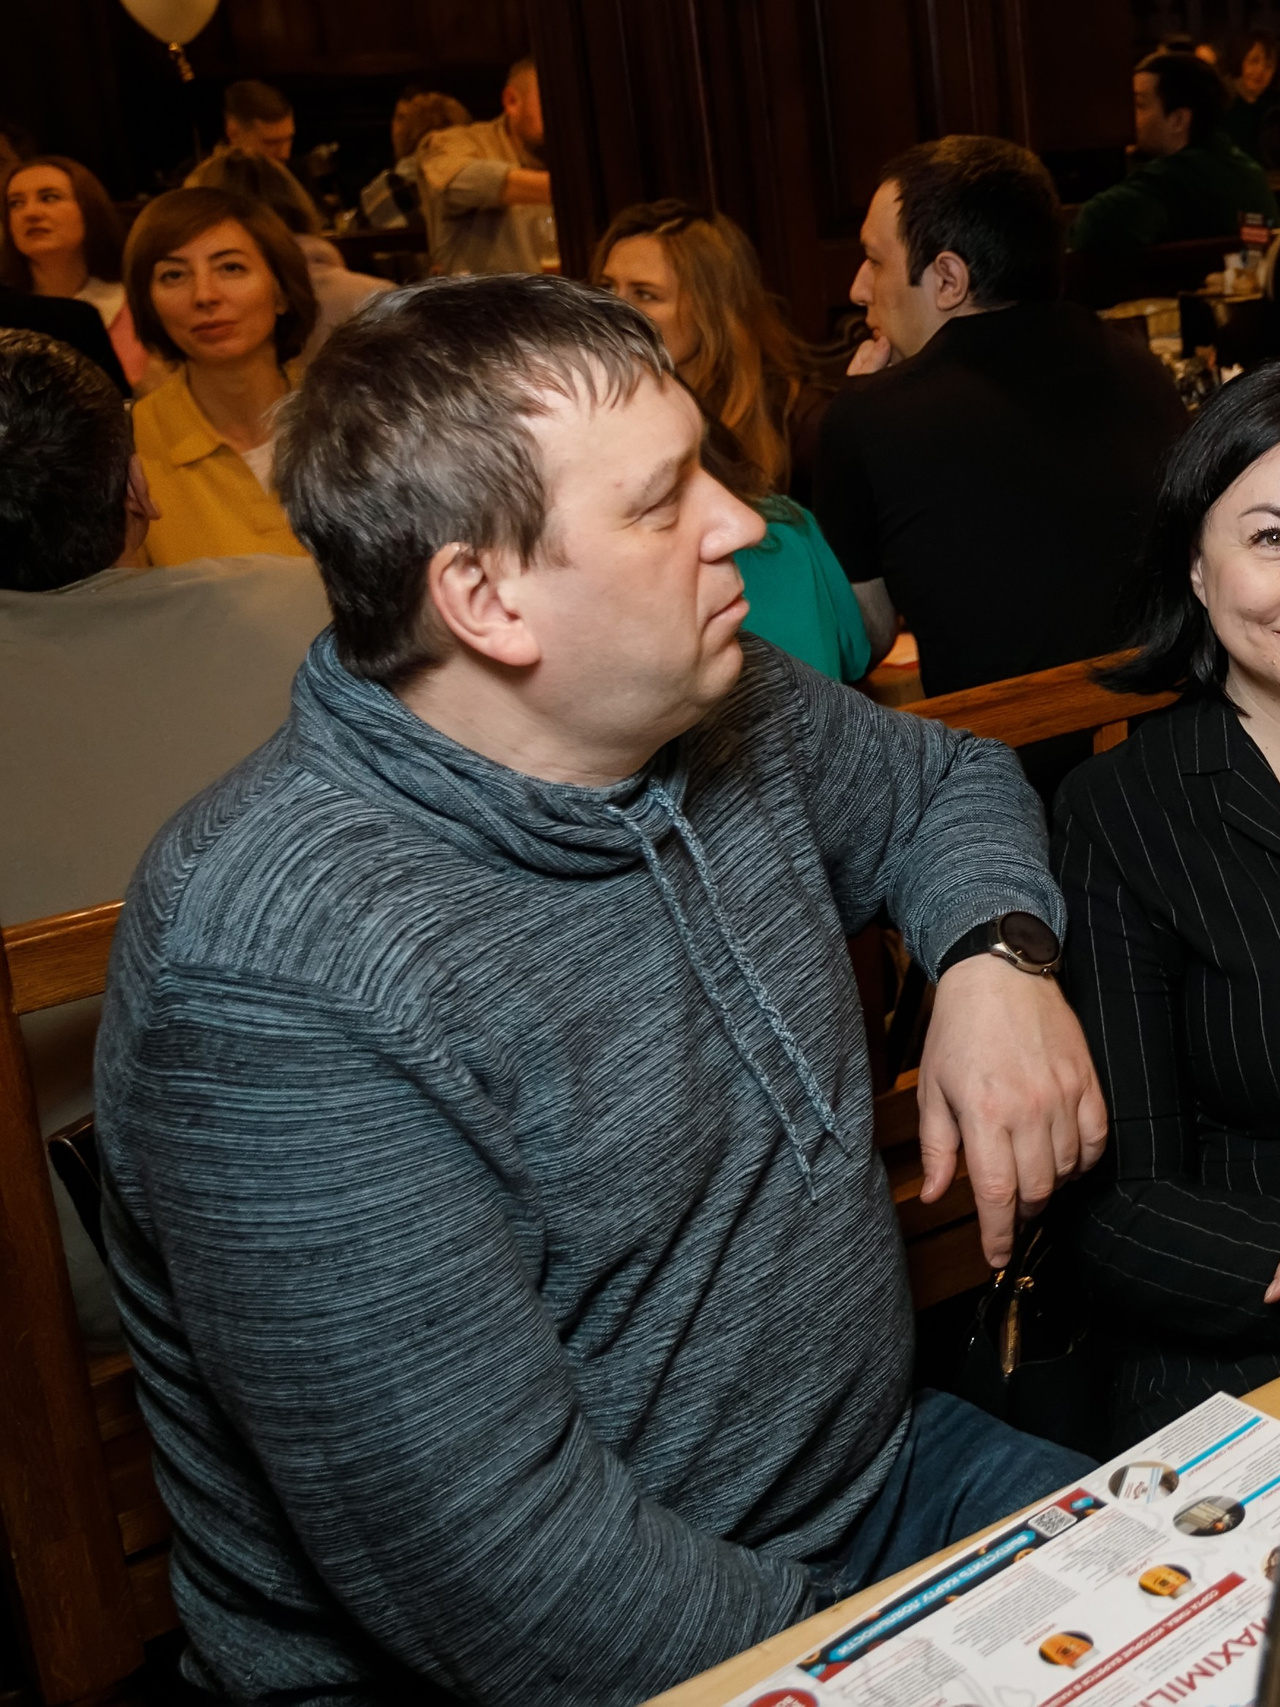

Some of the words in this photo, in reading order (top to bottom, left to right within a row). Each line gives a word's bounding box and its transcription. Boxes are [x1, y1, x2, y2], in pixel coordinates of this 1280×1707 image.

[1223, 1420, 1272, 1450] ПОДАРОЧНЫЙ
[1183, 1449, 1228, 1477] СЕРТИФИКАТ
[956, 1533, 1030, 1580] ВЫПУСТИТЬ
[917, 1574, 963, 1603] КАРТУ
[1188, 1588, 1221, 1609] СОРТА
[833, 1598, 924, 1657] ЛОЯЛЬНОСТИ
[1021, 1622, 1058, 1646] WEIZEN
[1118, 1626, 1166, 1657] КОТОРЫЕ
[1078, 1655, 1125, 1686] ВАРЯТСЯ
[1045, 1688, 1076, 1707] НАШ
